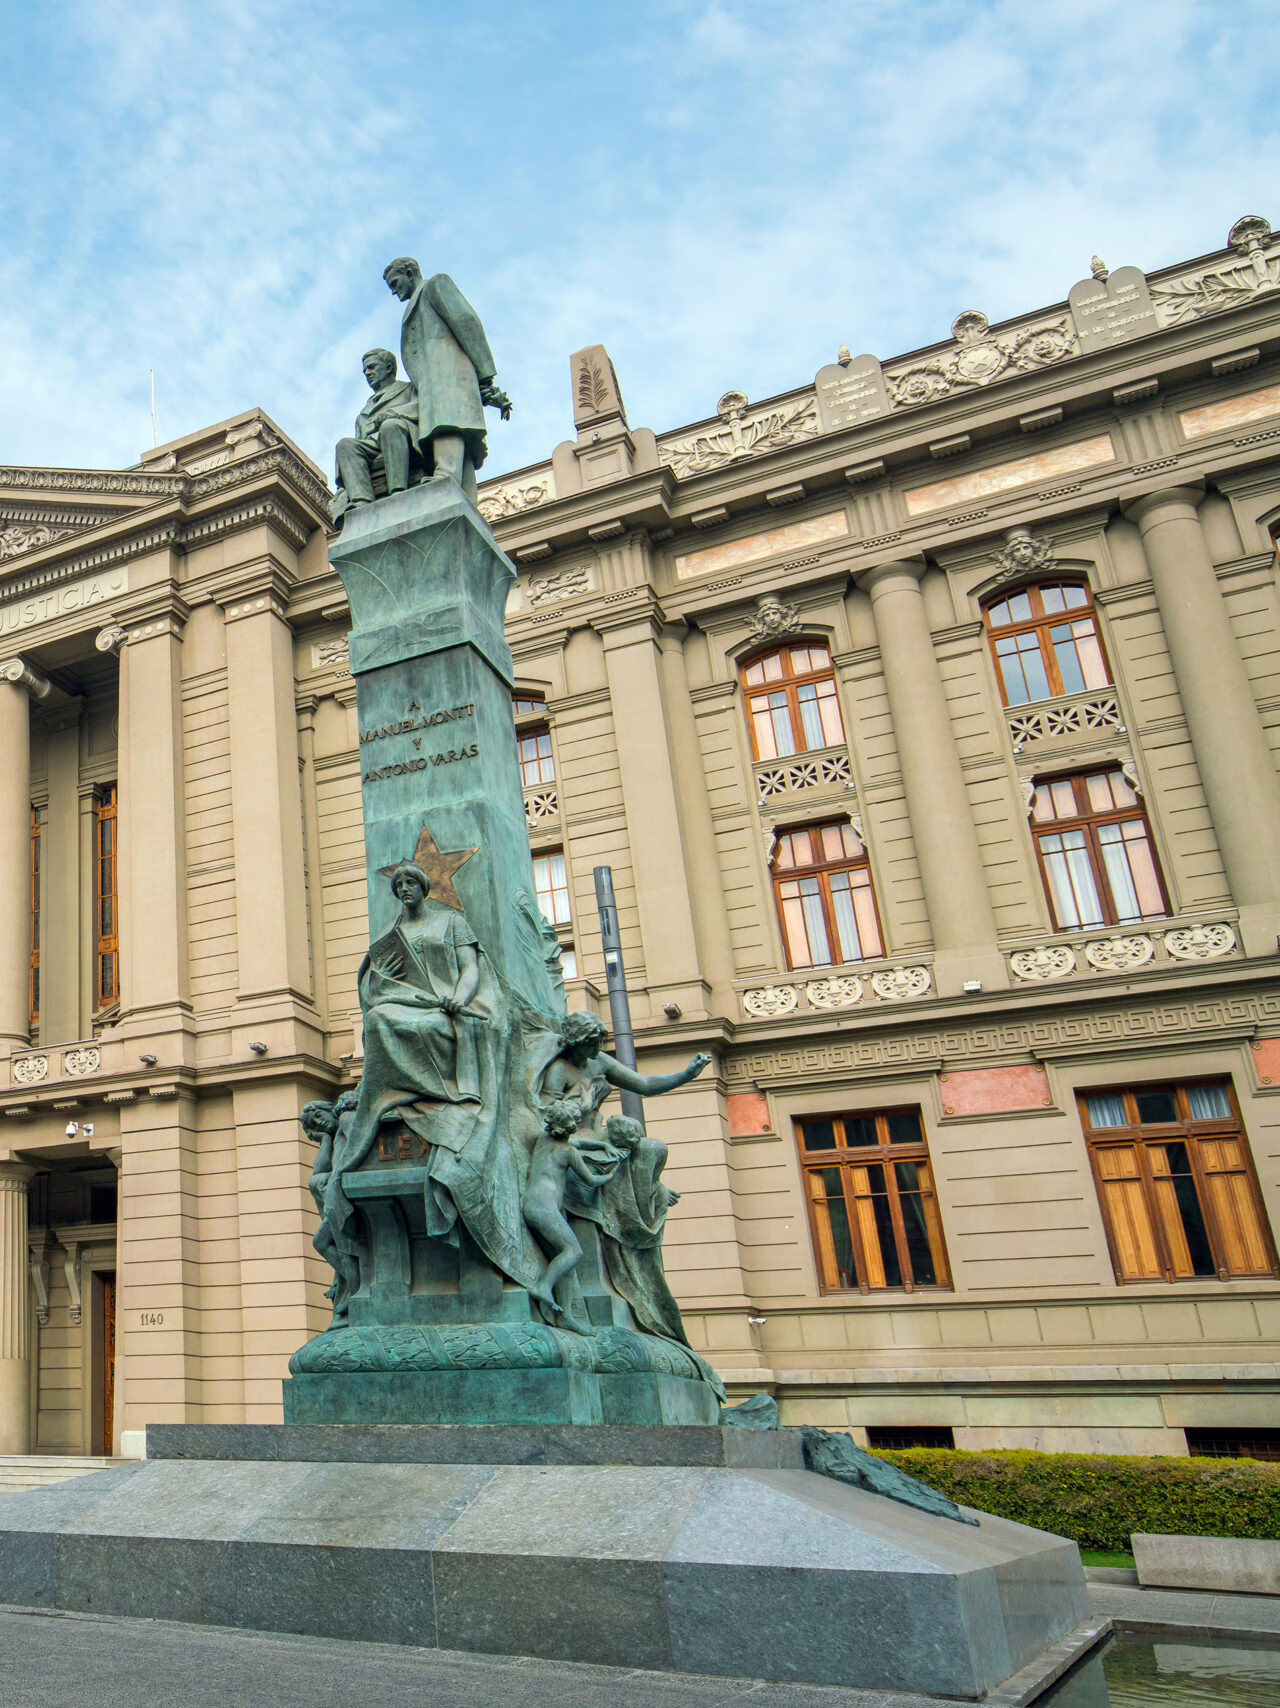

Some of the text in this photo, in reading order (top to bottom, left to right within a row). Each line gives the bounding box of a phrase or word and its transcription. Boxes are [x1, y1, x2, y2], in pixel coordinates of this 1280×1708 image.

[408, 699, 420, 712] A
[359, 703, 474, 744] MANUEL MONTT
[412, 737, 422, 751] Y
[363, 744, 480, 784] ANTONIO VARAS
[140, 1313, 164, 1326] 1140
